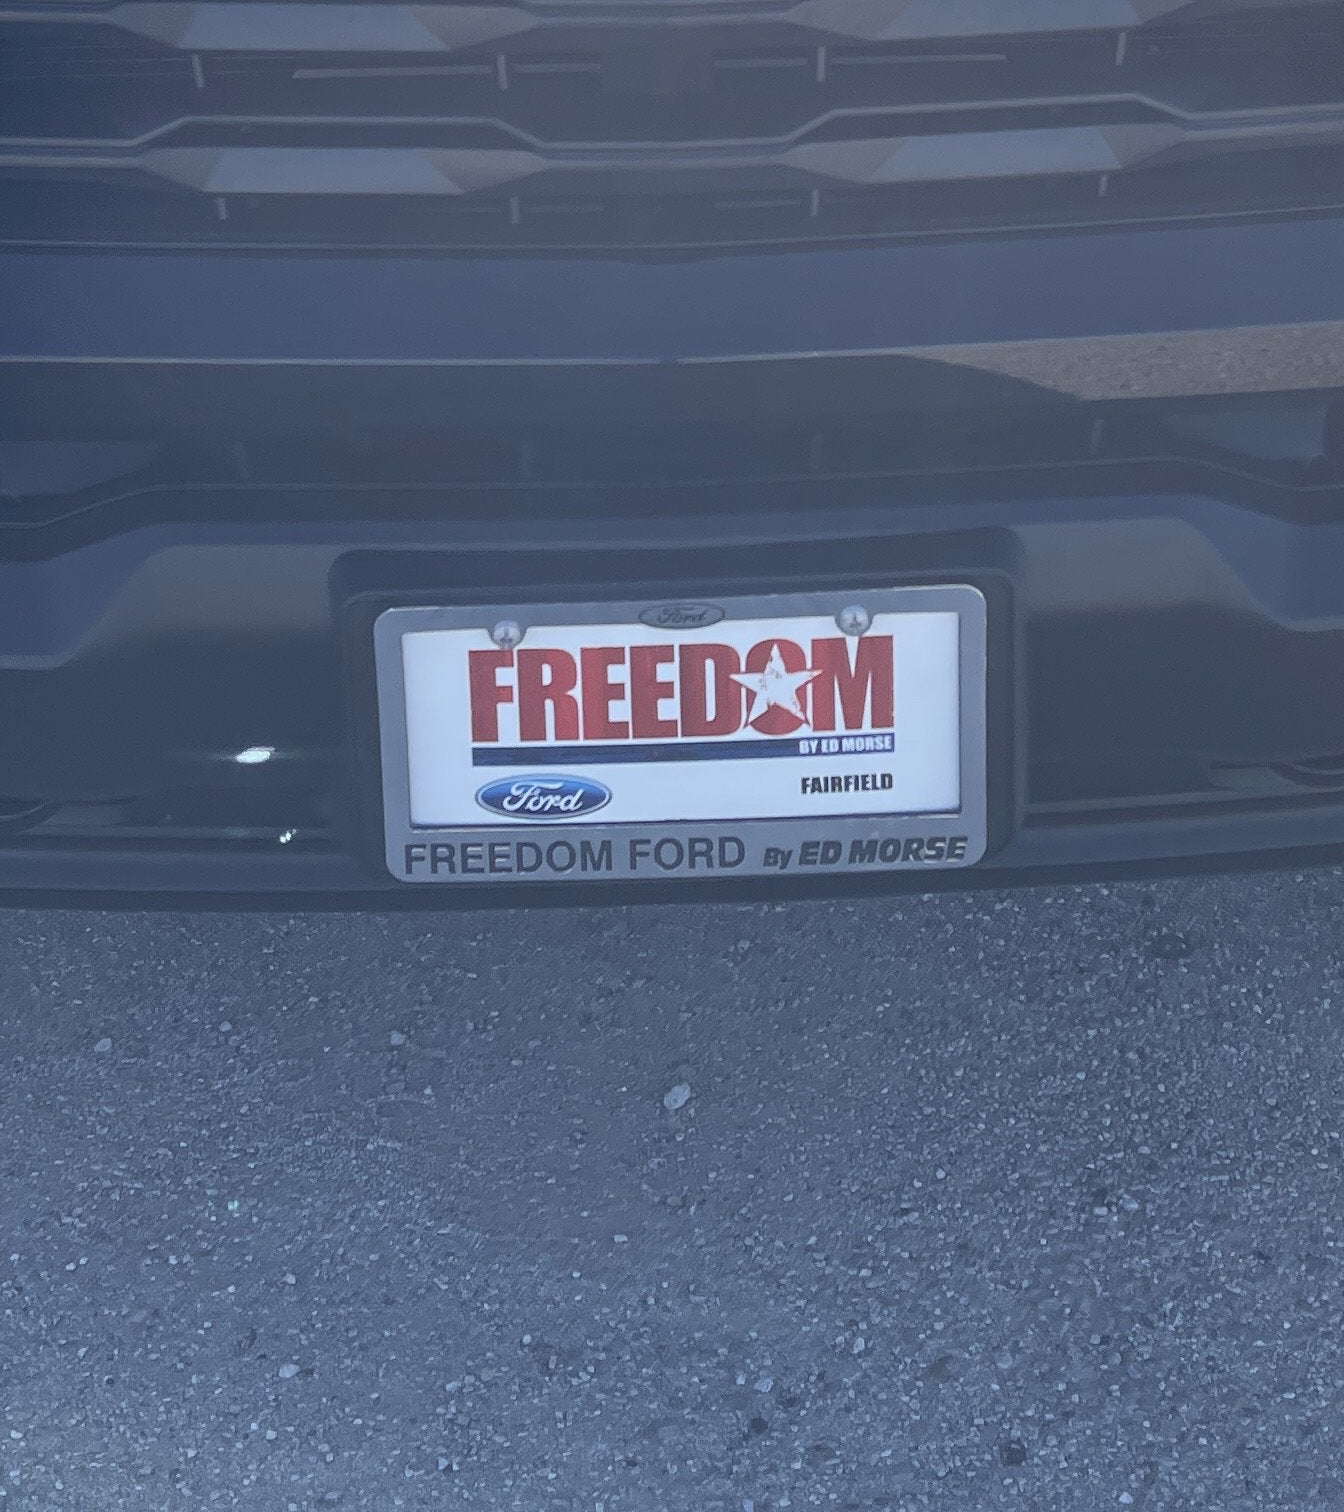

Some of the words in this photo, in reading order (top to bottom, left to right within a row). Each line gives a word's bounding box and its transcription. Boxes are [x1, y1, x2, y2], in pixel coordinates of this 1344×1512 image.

[468, 635, 895, 743] FREEDOM
[799, 739, 818, 754] BY
[821, 738, 840, 753] ED
[842, 735, 892, 752] MORSE
[801, 774, 893, 794] FAIRFIELD
[405, 839, 613, 875] FREEDOM
[629, 836, 746, 871] FORD
[763, 847, 793, 870] By
[798, 840, 843, 866] ED
[848, 836, 968, 864] MORSE
